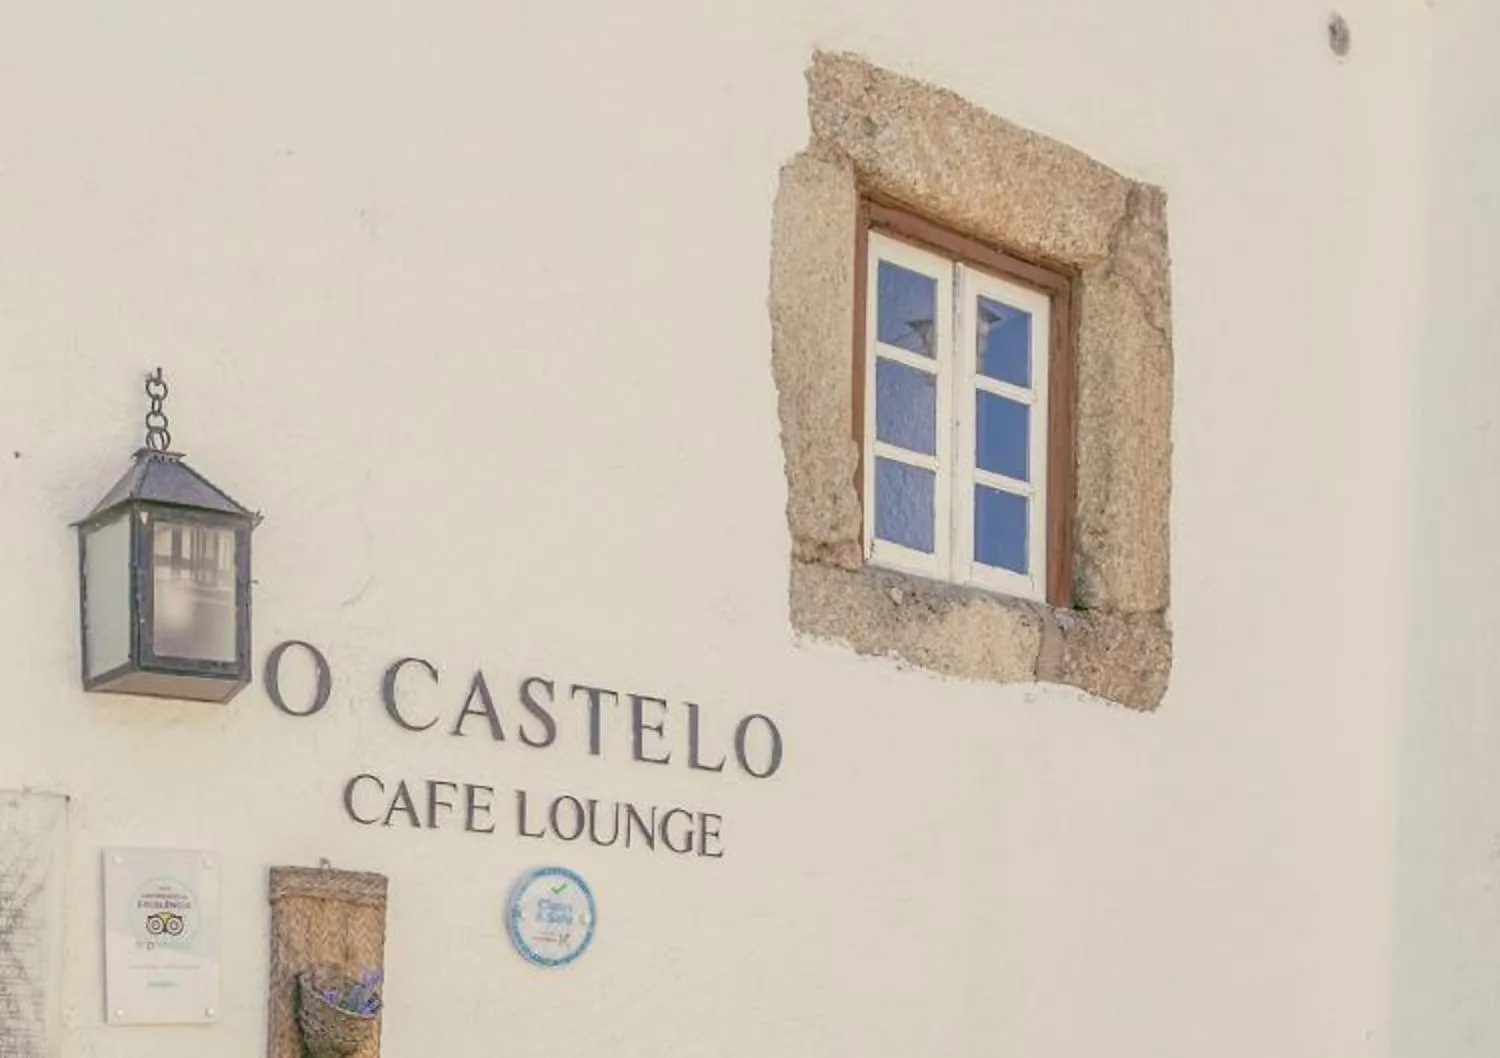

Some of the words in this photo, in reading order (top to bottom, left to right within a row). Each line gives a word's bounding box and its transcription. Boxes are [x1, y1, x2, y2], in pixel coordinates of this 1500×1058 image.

[263, 640, 332, 717] O
[381, 656, 784, 779] CASTELO
[343, 773, 495, 834] CAFE
[516, 790, 724, 859] LOUNGE
